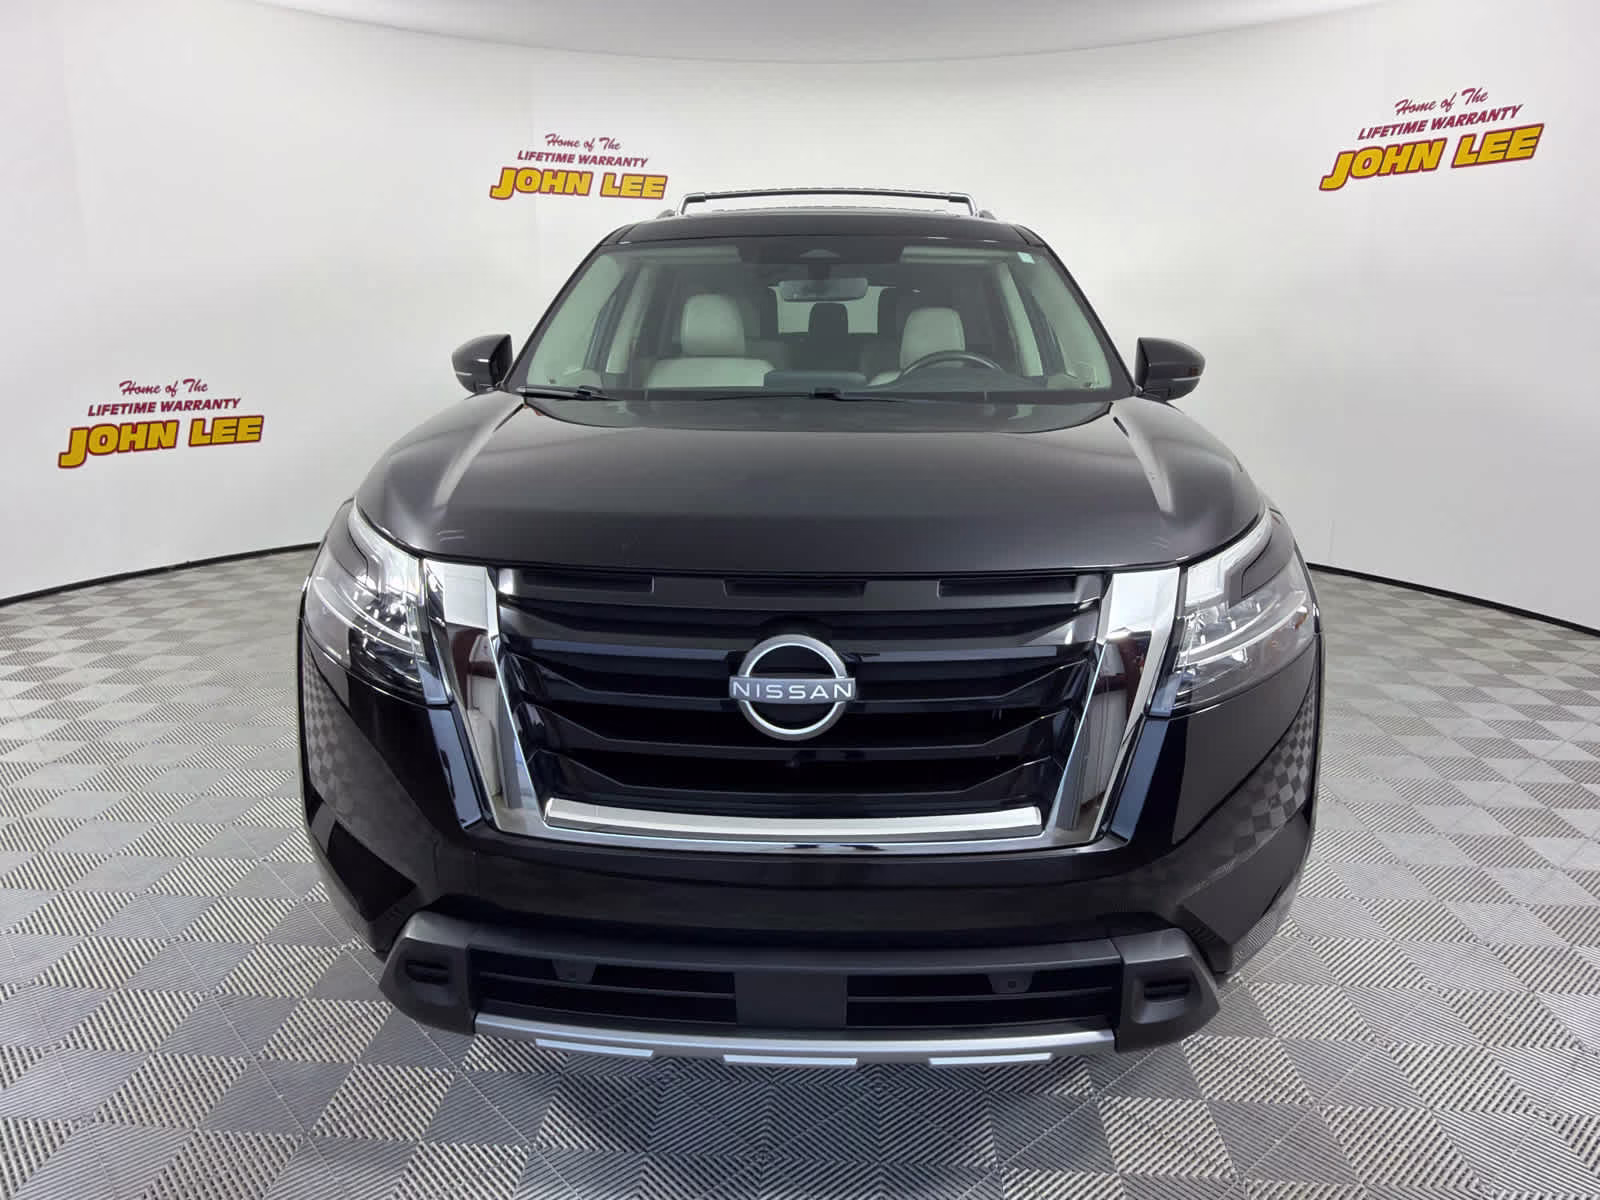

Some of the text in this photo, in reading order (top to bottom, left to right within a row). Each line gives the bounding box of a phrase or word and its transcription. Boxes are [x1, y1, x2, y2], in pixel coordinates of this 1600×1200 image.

[1395, 87, 1488, 116] Home of The
[1358, 104, 1523, 140] LIFETIME WARRANTY
[545, 133, 621, 150] Home of The
[517, 150, 648, 168] LIFETIME WARRANTY
[1319, 123, 1544, 191] JOHN LEE
[489, 167, 668, 200] JOHN LEE
[119, 378, 208, 396] Home of The
[88, 398, 241, 417] LIFETIME WARRANTY
[58, 415, 264, 468] JOHN LEE
[732, 681, 852, 700] NISSAN
